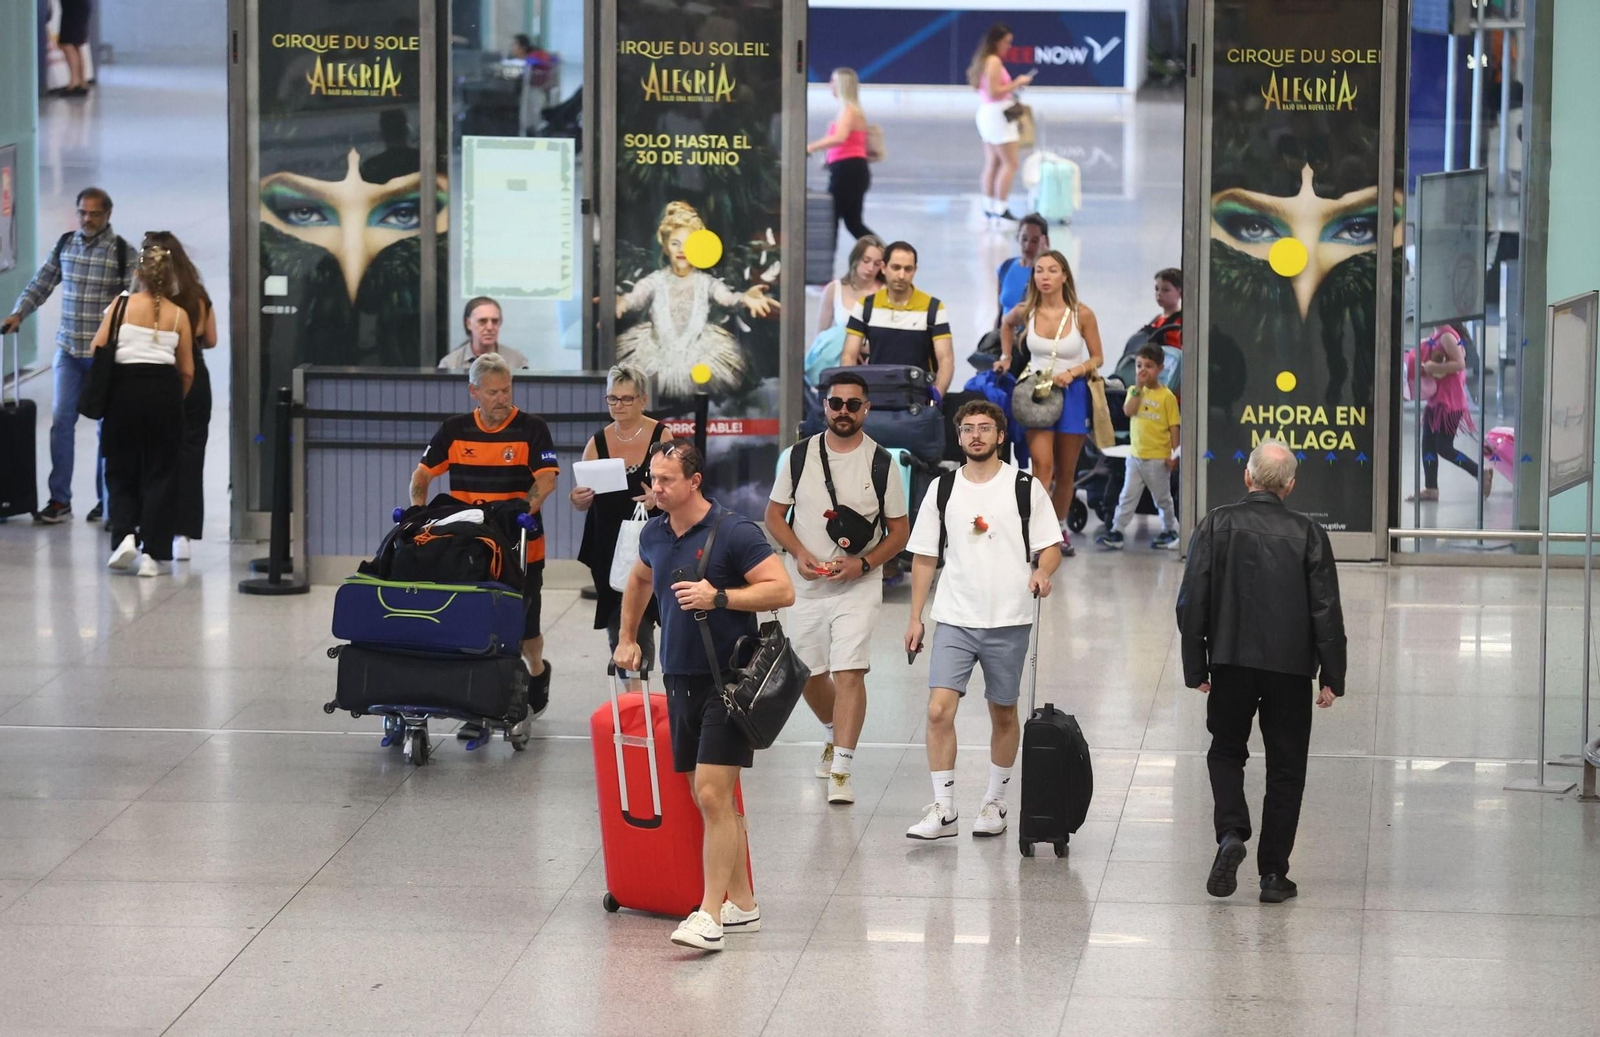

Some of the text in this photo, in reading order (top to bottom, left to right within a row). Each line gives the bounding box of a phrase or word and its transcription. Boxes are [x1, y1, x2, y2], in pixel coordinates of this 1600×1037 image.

[272, 33, 420, 53] CIRQUE DU SOLE
[619, 40, 770, 59] IRQUE DU SOLEIL
[1227, 48, 1296, 68] CIRQUE
[1300, 49, 1326, 64] DU
[306, 55, 402, 97] ALEGRÍA
[640, 61, 736, 102] ALEGRÍA
[1260, 69, 1358, 111] ALEGRÍA
[623, 133, 752, 149] SOLO HASTA EL
[636, 150, 740, 166] 30 DE JUNIO
[1240, 405, 1366, 426] AHORA EN
[1251, 424, 1356, 450] MÁLAGA
[1321, 523, 1347, 532] ruptive
[839, 752, 854, 760] VAN
